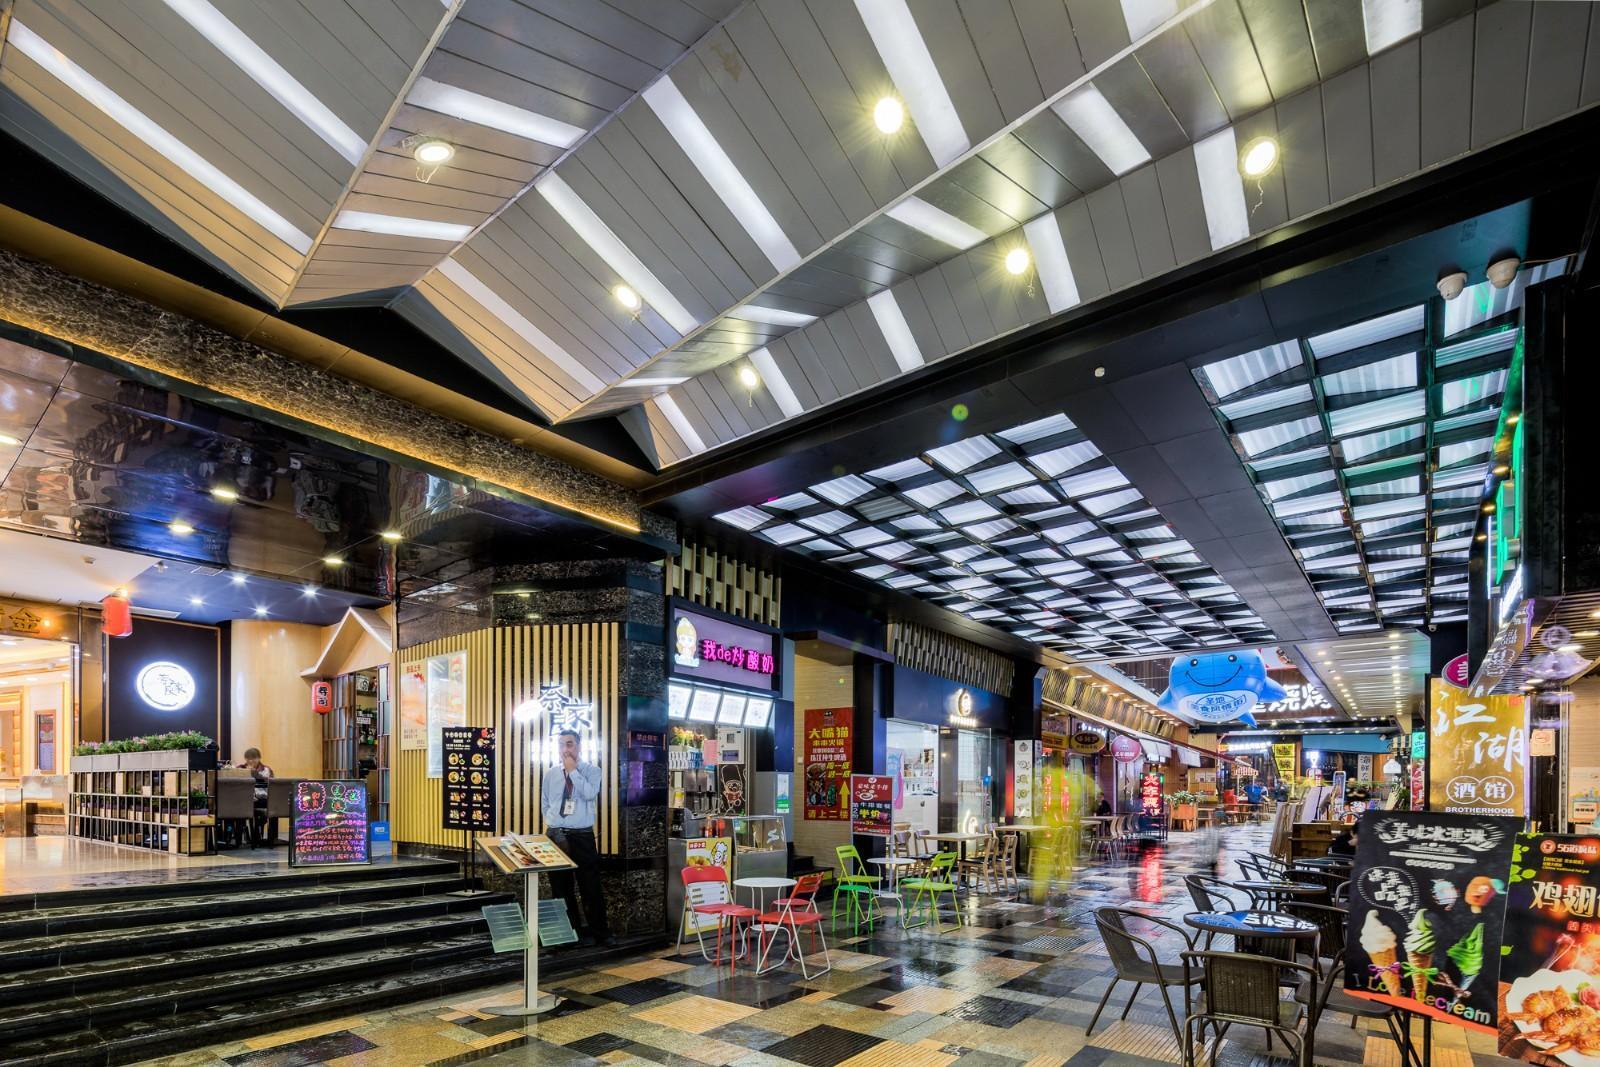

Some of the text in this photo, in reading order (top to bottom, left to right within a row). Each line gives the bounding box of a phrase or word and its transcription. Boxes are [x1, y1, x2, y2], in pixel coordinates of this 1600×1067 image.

[703, 640, 774, 673] 我de炒酸奶
[1453, 781, 1508, 799] 酒馆
[1445, 806, 1515, 814] BROTHERHOOD
[1529, 881, 1600, 918] 鸡翅
[1367, 976, 1407, 996] Loe
[1411, 989, 1491, 1025] Iecream
